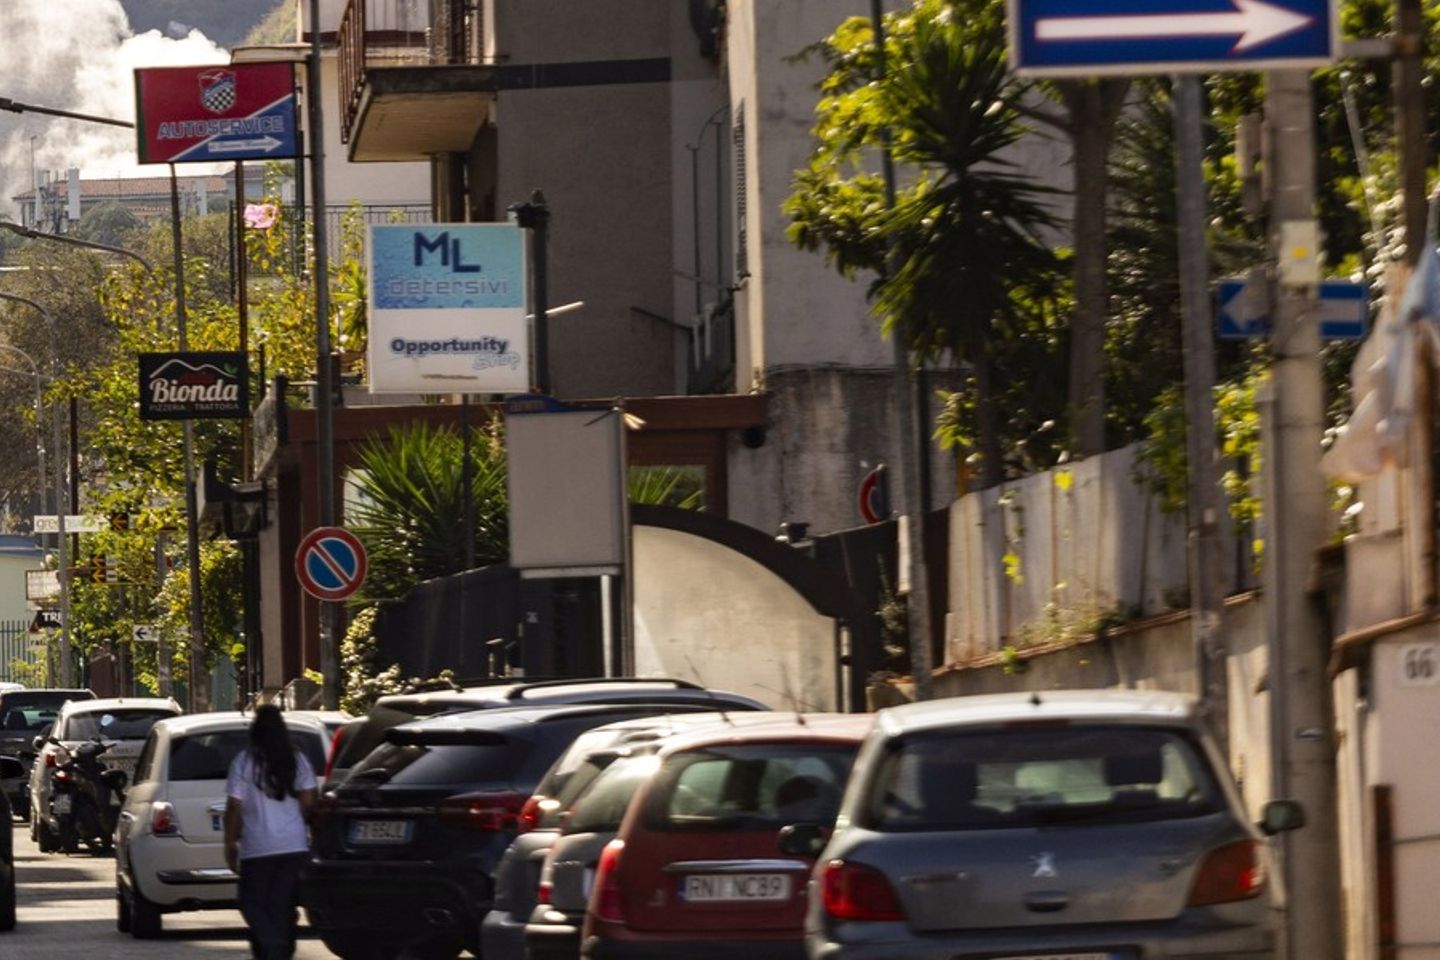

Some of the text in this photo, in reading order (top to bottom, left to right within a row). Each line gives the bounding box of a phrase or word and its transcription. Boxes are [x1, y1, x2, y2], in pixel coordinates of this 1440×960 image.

[157, 115, 285, 140] AUTOSERVICE
[389, 277, 508, 296] detersivi
[391, 338, 509, 356] Opportunity
[149, 378, 238, 403] Bionda
[1404, 647, 1434, 680] 66
